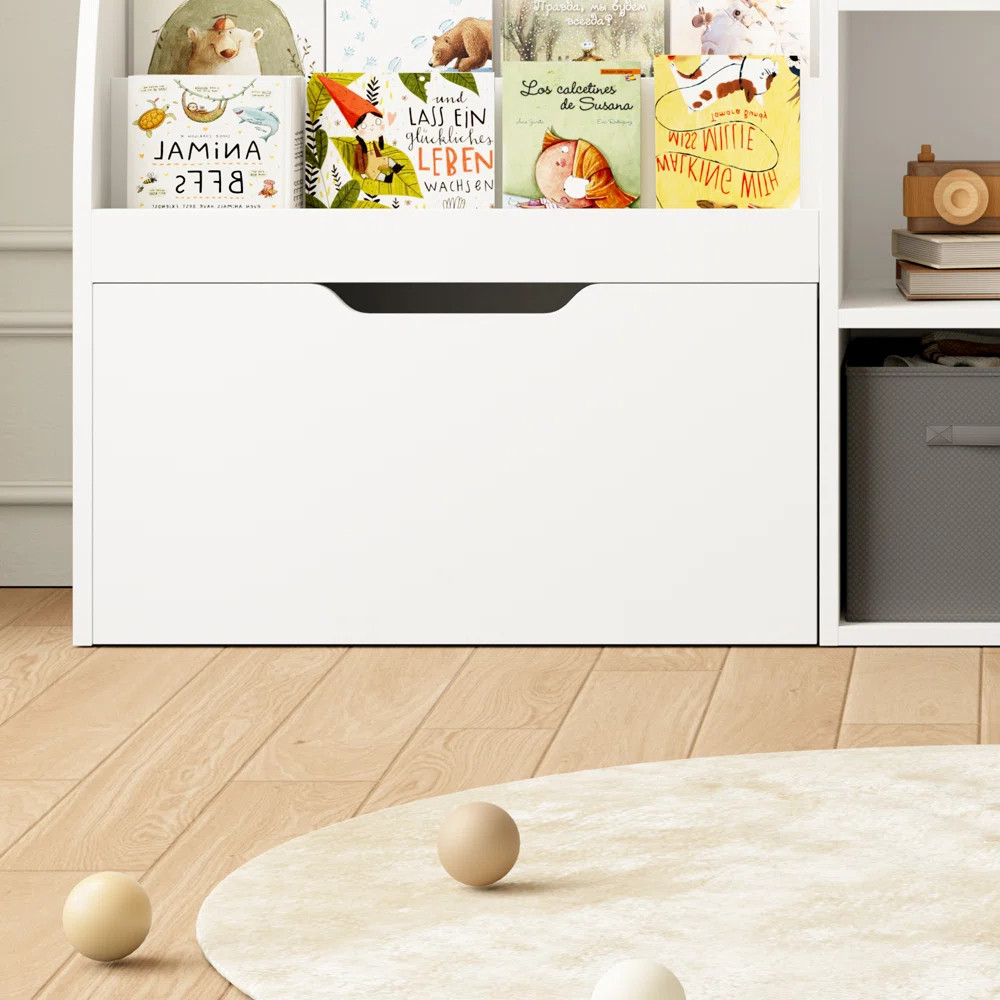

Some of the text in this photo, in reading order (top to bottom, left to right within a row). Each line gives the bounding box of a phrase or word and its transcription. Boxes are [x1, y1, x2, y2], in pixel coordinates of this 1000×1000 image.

[533, 0, 648, 17] Правда, мы будем
[566, 12, 613, 27] всегда?
[520, 79, 617, 97] Los calcetines
[433, 90, 468, 104] und
[560, 96, 634, 112] de Susana
[408, 105, 444, 127] LASS
[405, 125, 493, 151] glückliches
[418, 146, 493, 177] LEBEN
